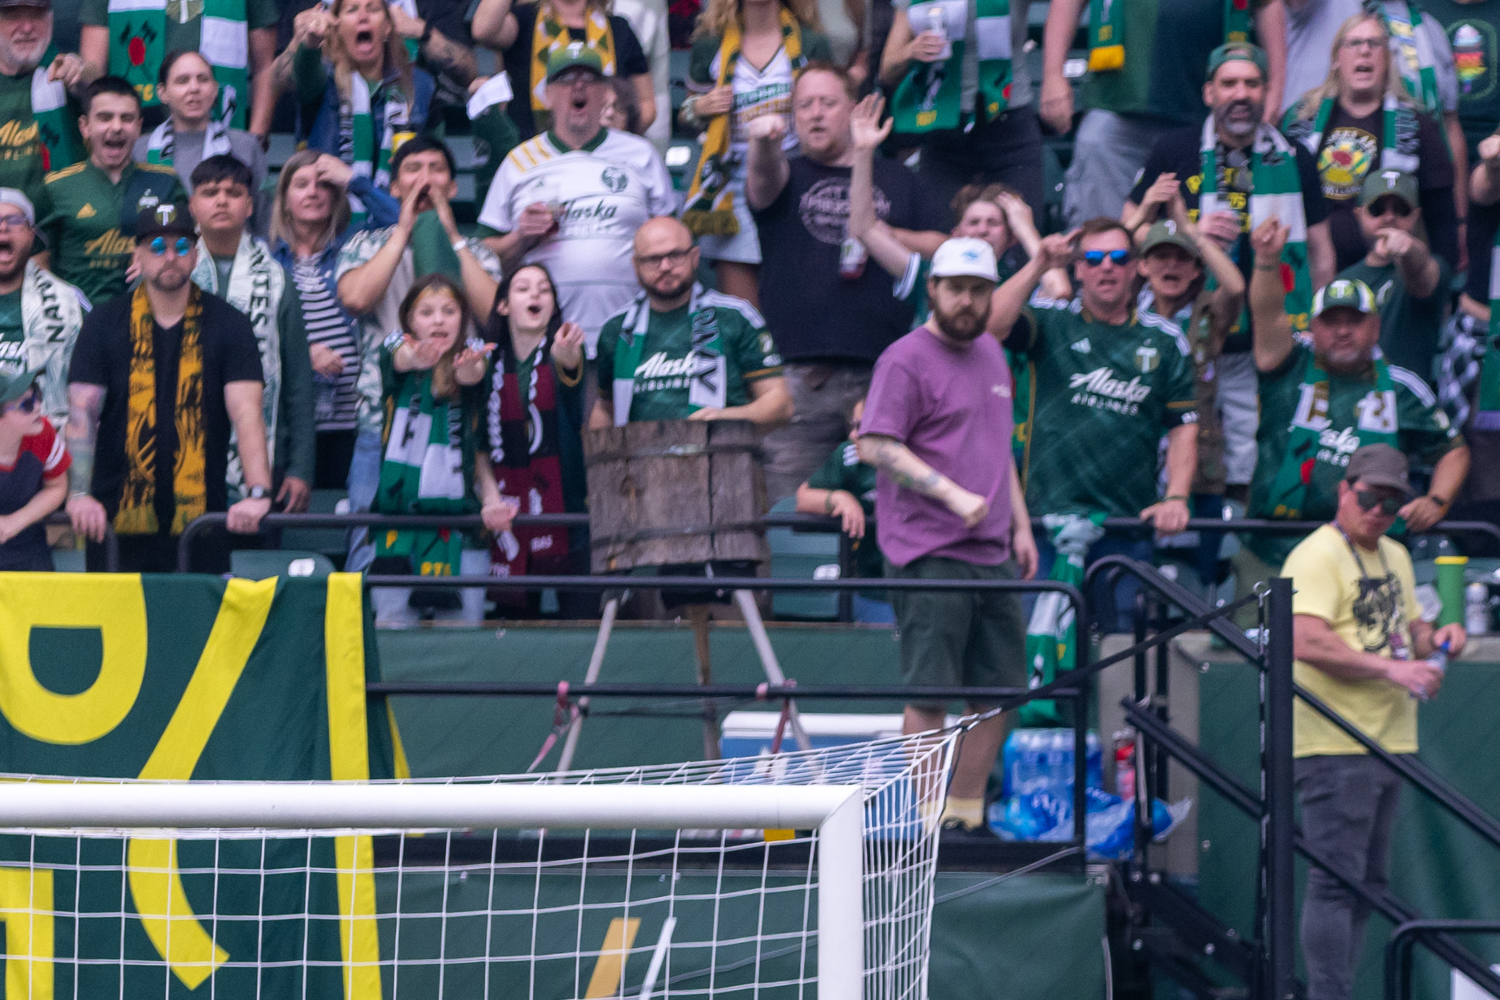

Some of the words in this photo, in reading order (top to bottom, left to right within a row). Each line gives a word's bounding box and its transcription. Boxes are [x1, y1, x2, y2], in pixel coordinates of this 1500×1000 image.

[634, 378, 693, 394] AIRLINE
[1069, 366, 1152, 404] Alaska
[1070, 392, 1140, 416] AIRLINES
